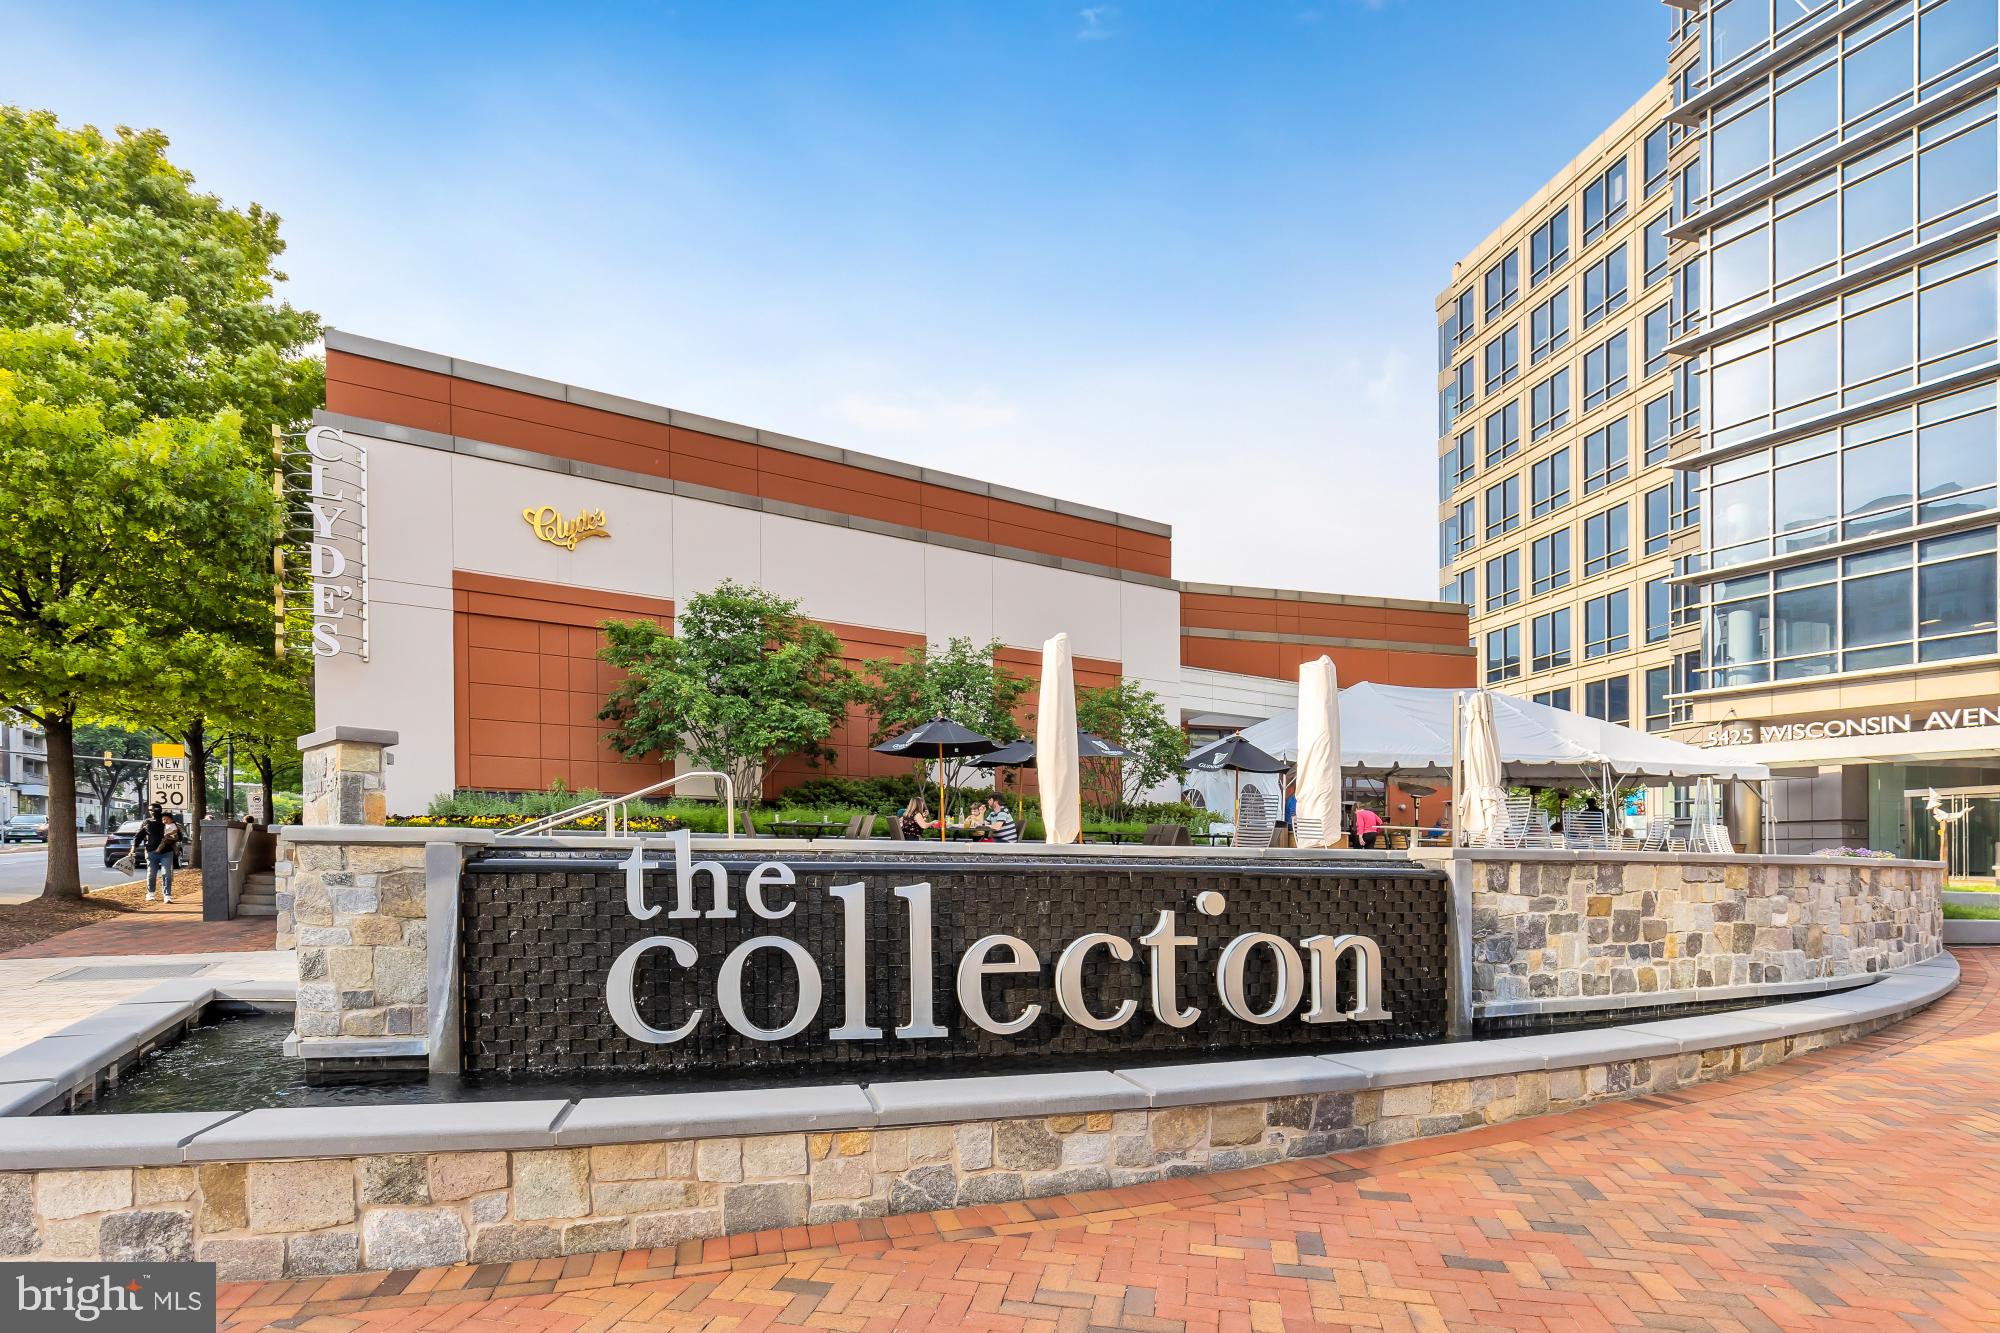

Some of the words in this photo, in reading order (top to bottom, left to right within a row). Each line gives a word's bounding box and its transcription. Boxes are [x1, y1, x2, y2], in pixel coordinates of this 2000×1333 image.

[522, 505, 611, 552] Clyde's
[305, 425, 353, 657] CLYDE'S
[1707, 728, 1754, 746] 5425
[1760, 714, 1911, 744] WISCONSIN
[156, 758, 180, 769] NEW
[153, 774, 185, 782] SPEED
[156, 782, 182, 790] LIMIT
[155, 791, 184, 806] 30
[618, 828, 797, 921] the
